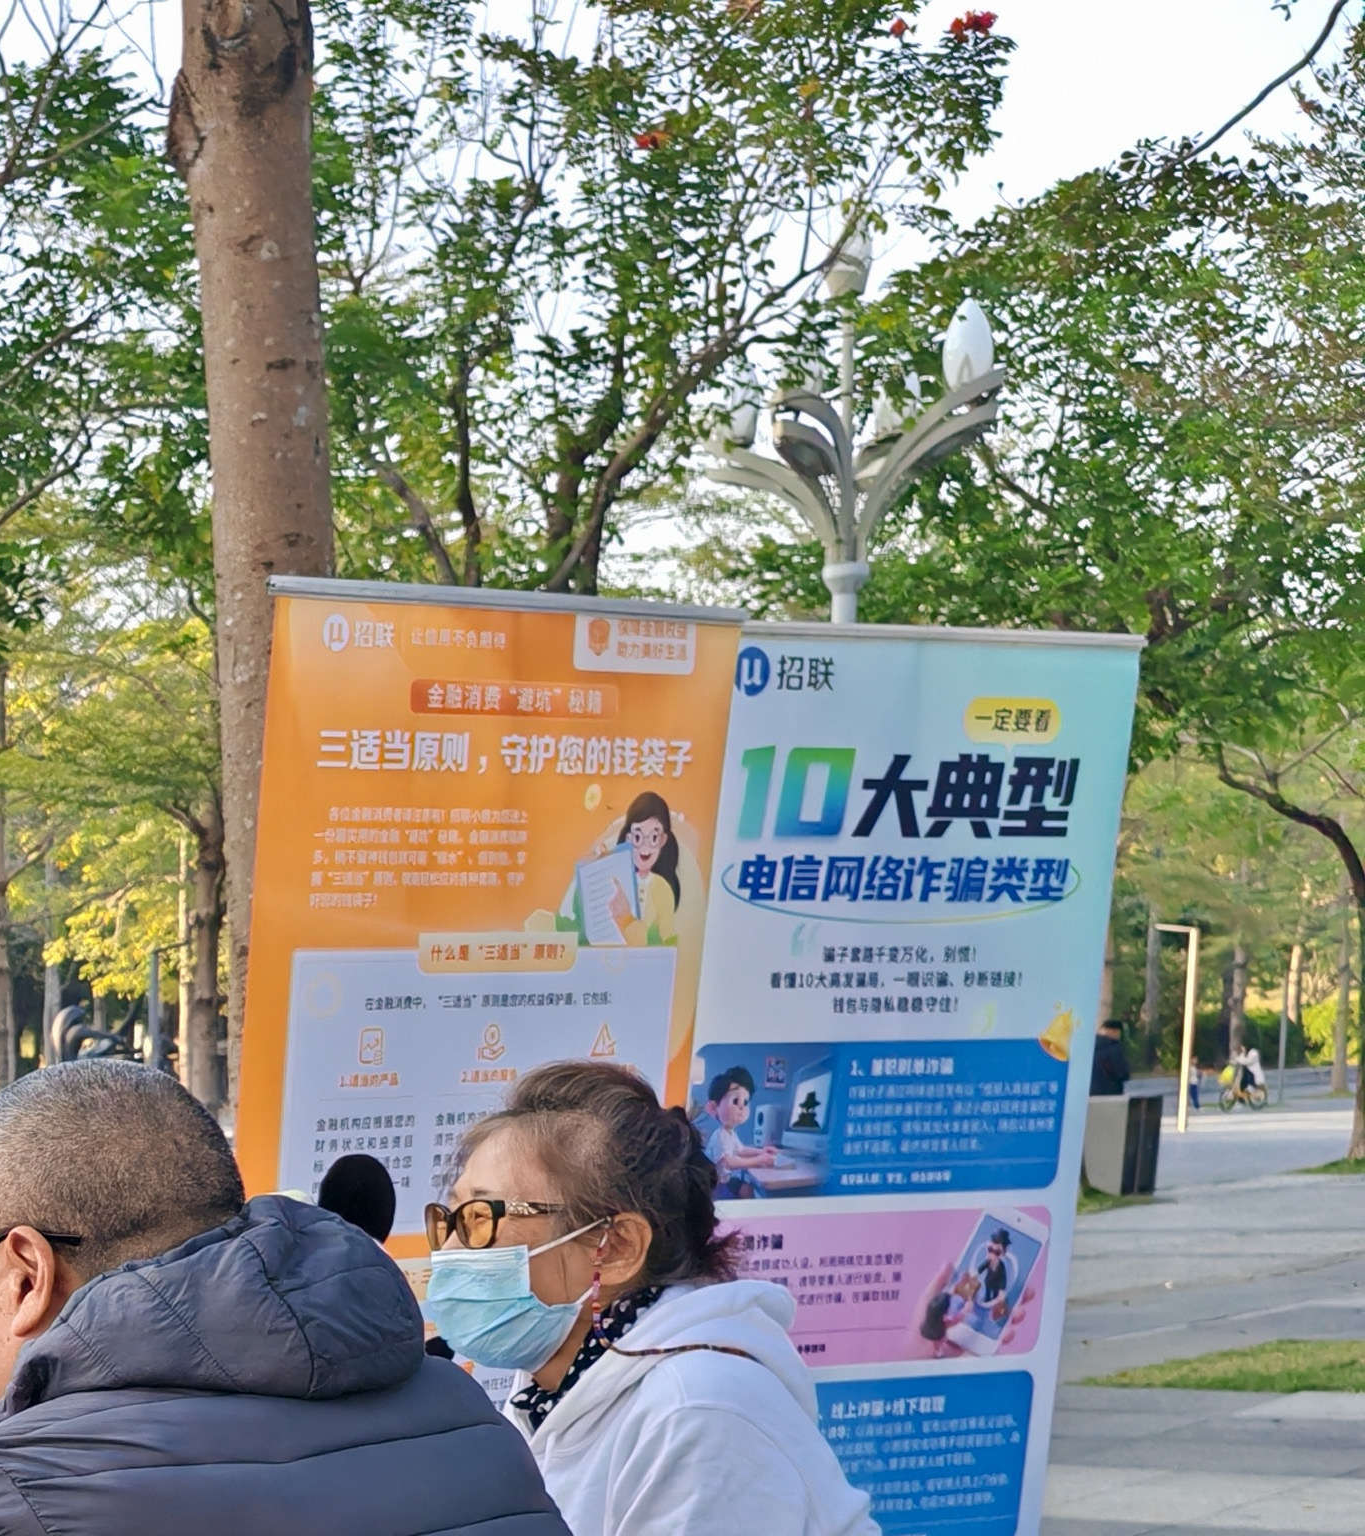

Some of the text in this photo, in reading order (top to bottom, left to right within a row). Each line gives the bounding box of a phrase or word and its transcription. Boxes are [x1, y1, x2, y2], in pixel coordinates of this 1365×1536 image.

[777, 655, 836, 692] 招联
[975, 707, 1052, 734] 一定要看
[736, 745, 1080, 841] 10大典型
[736, 854, 1073, 903] 电信网络诈骗类型
